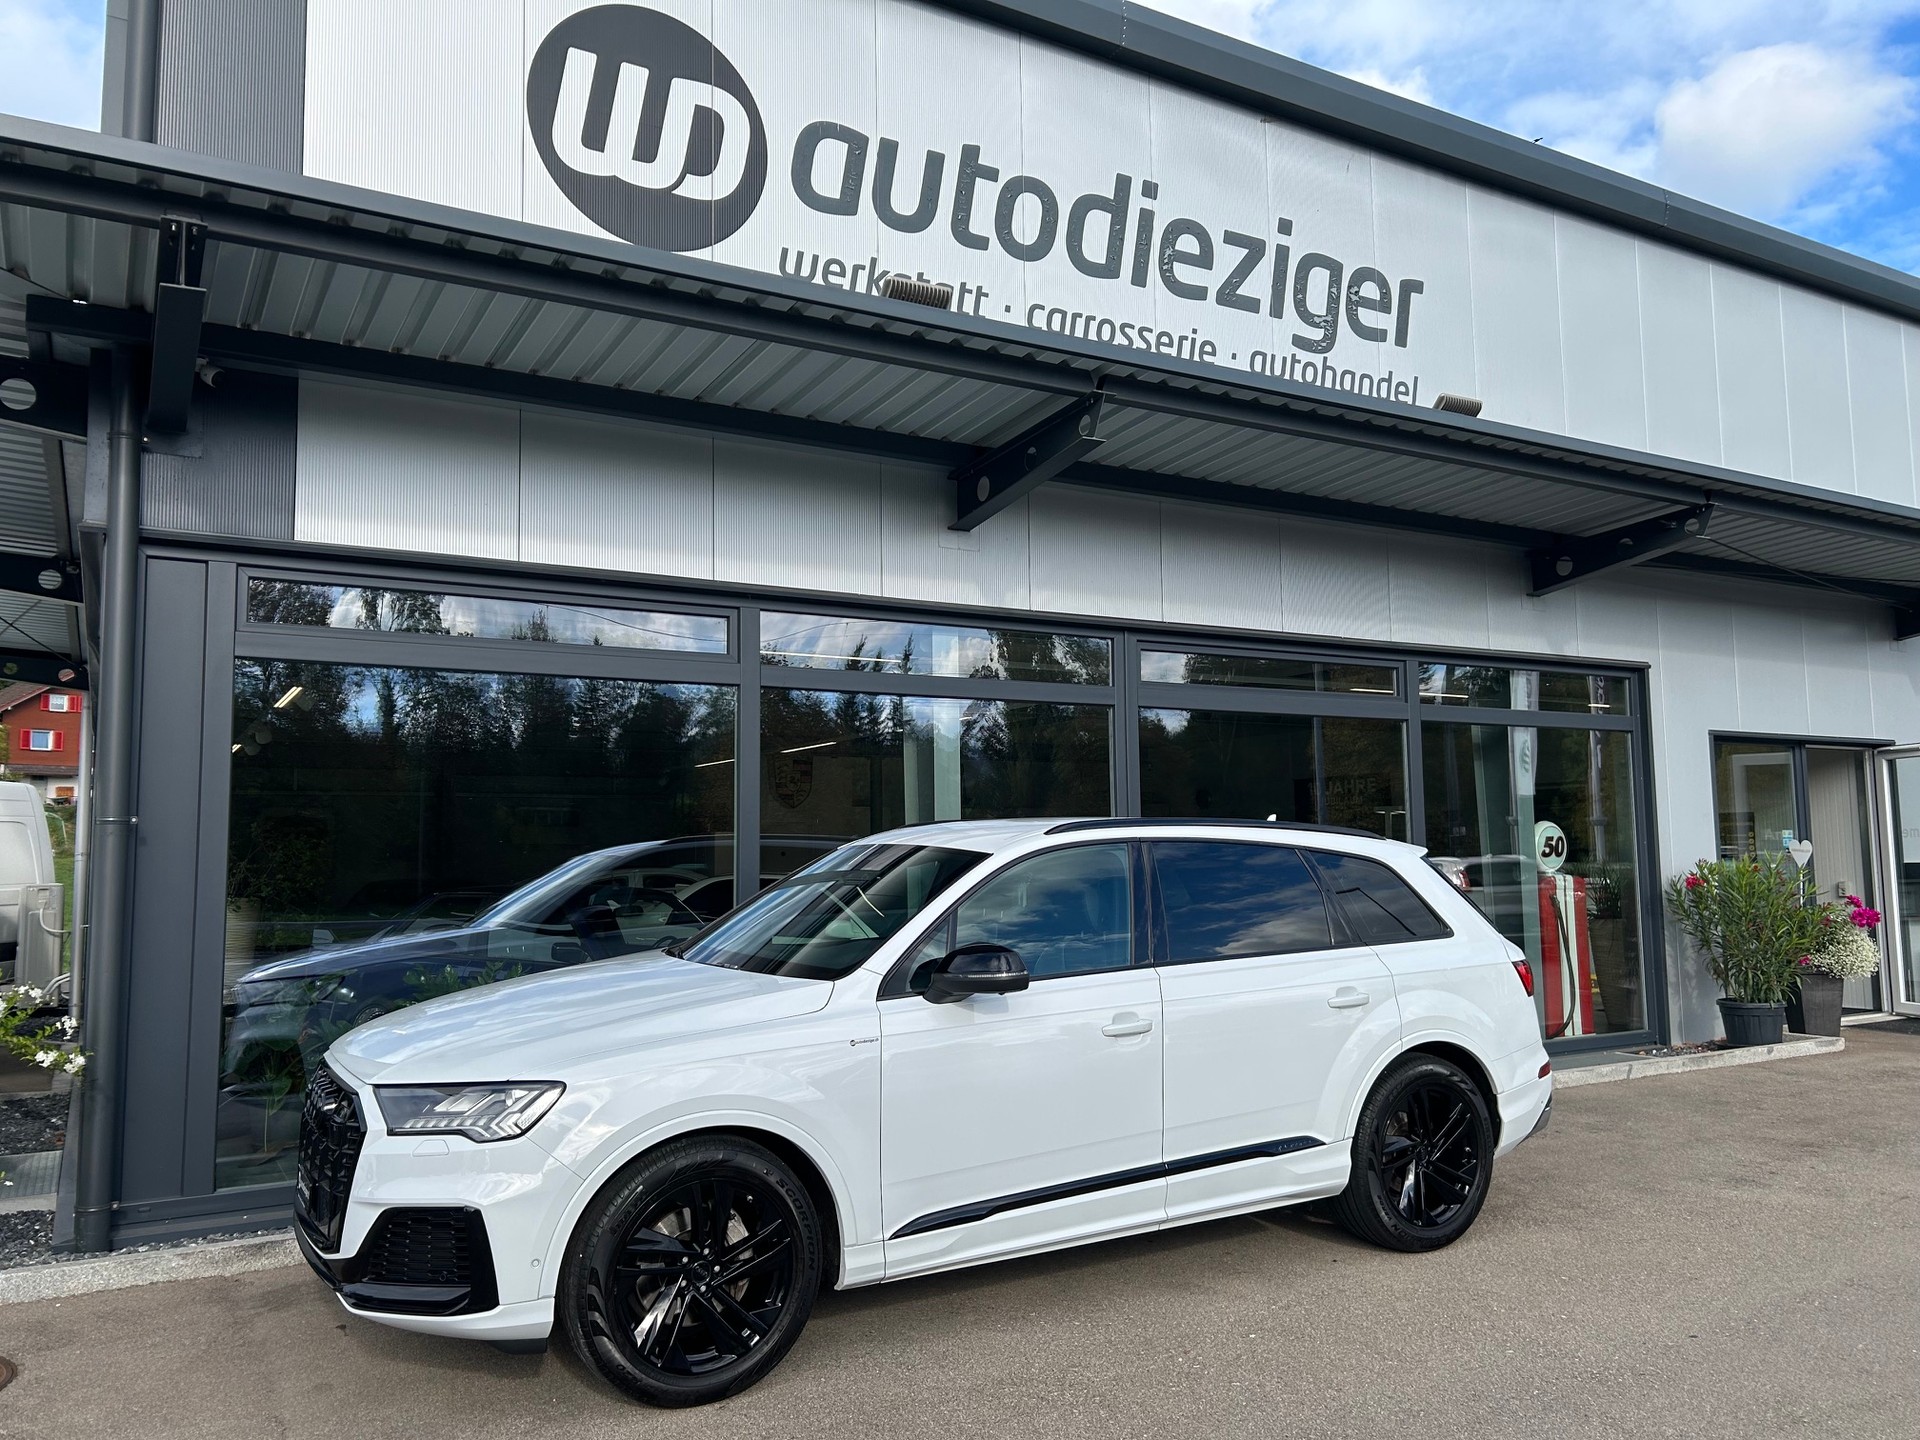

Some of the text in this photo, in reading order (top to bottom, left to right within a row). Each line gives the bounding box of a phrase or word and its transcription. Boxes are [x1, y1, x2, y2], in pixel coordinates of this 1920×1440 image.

[790, 120, 1424, 354] autodieziger
[778, 246, 1419, 406] werktt carrosserie autohandel
[1540, 835, 1565, 858] 50
